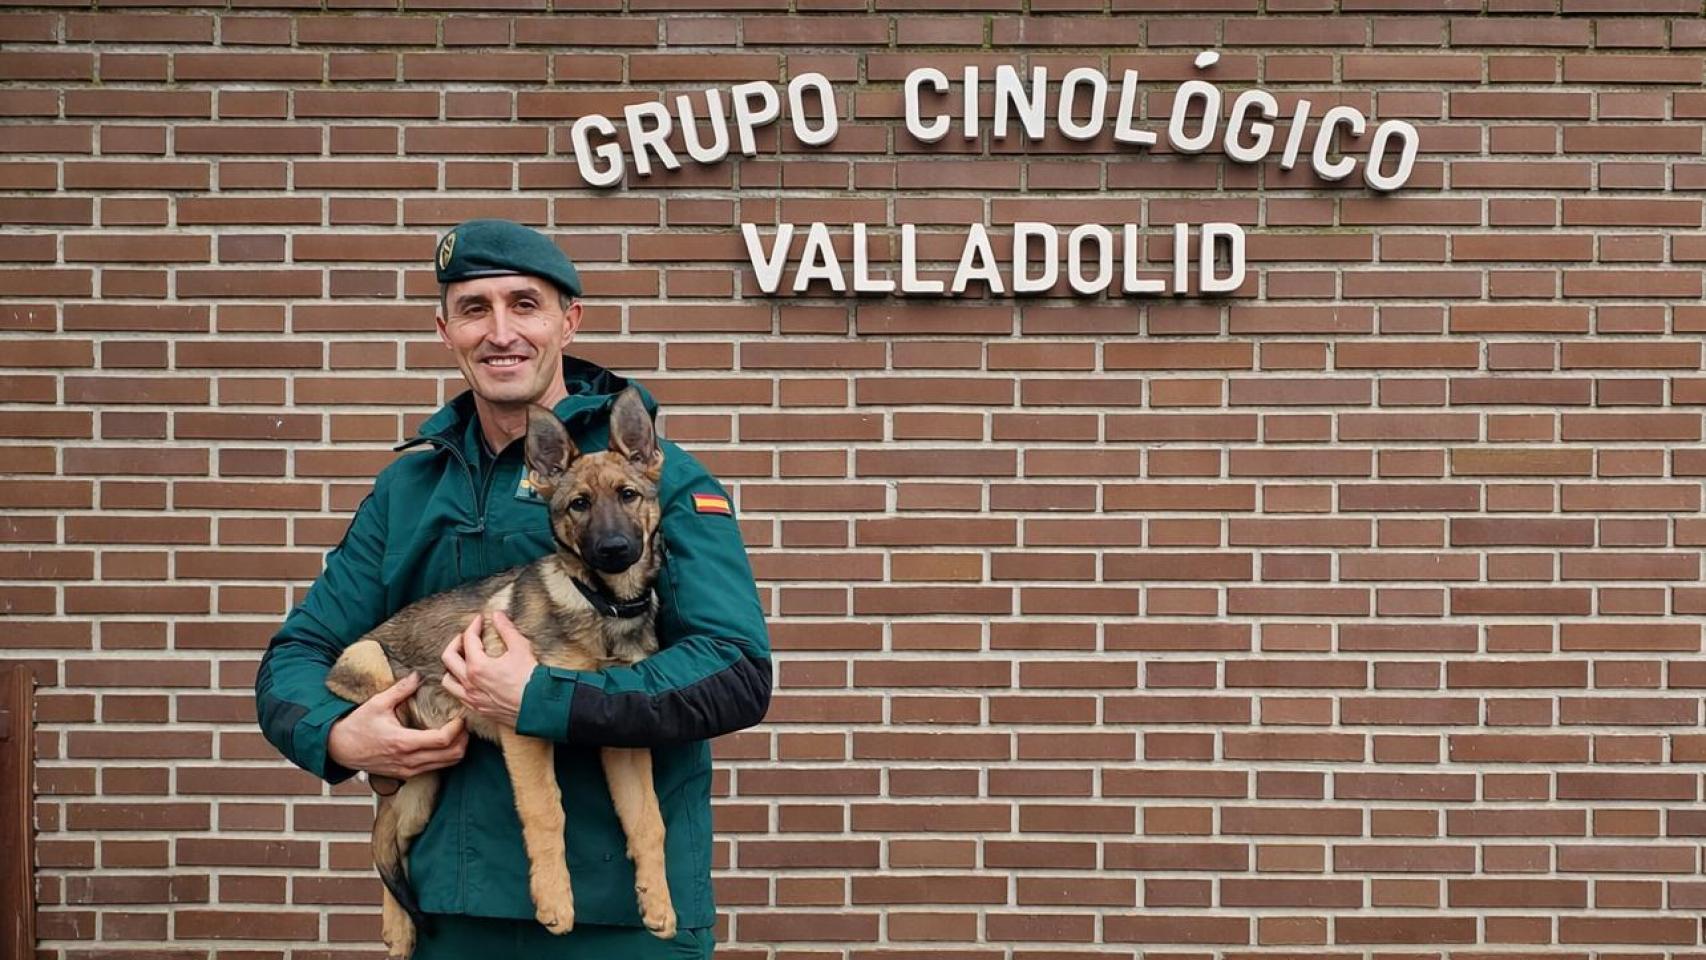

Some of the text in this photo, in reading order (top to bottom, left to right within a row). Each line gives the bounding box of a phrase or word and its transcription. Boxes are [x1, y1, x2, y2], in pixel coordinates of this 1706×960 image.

[571, 50, 1420, 193] GRUPO CINOLÓGICO
[741, 222, 1247, 295] VALLADOLID
